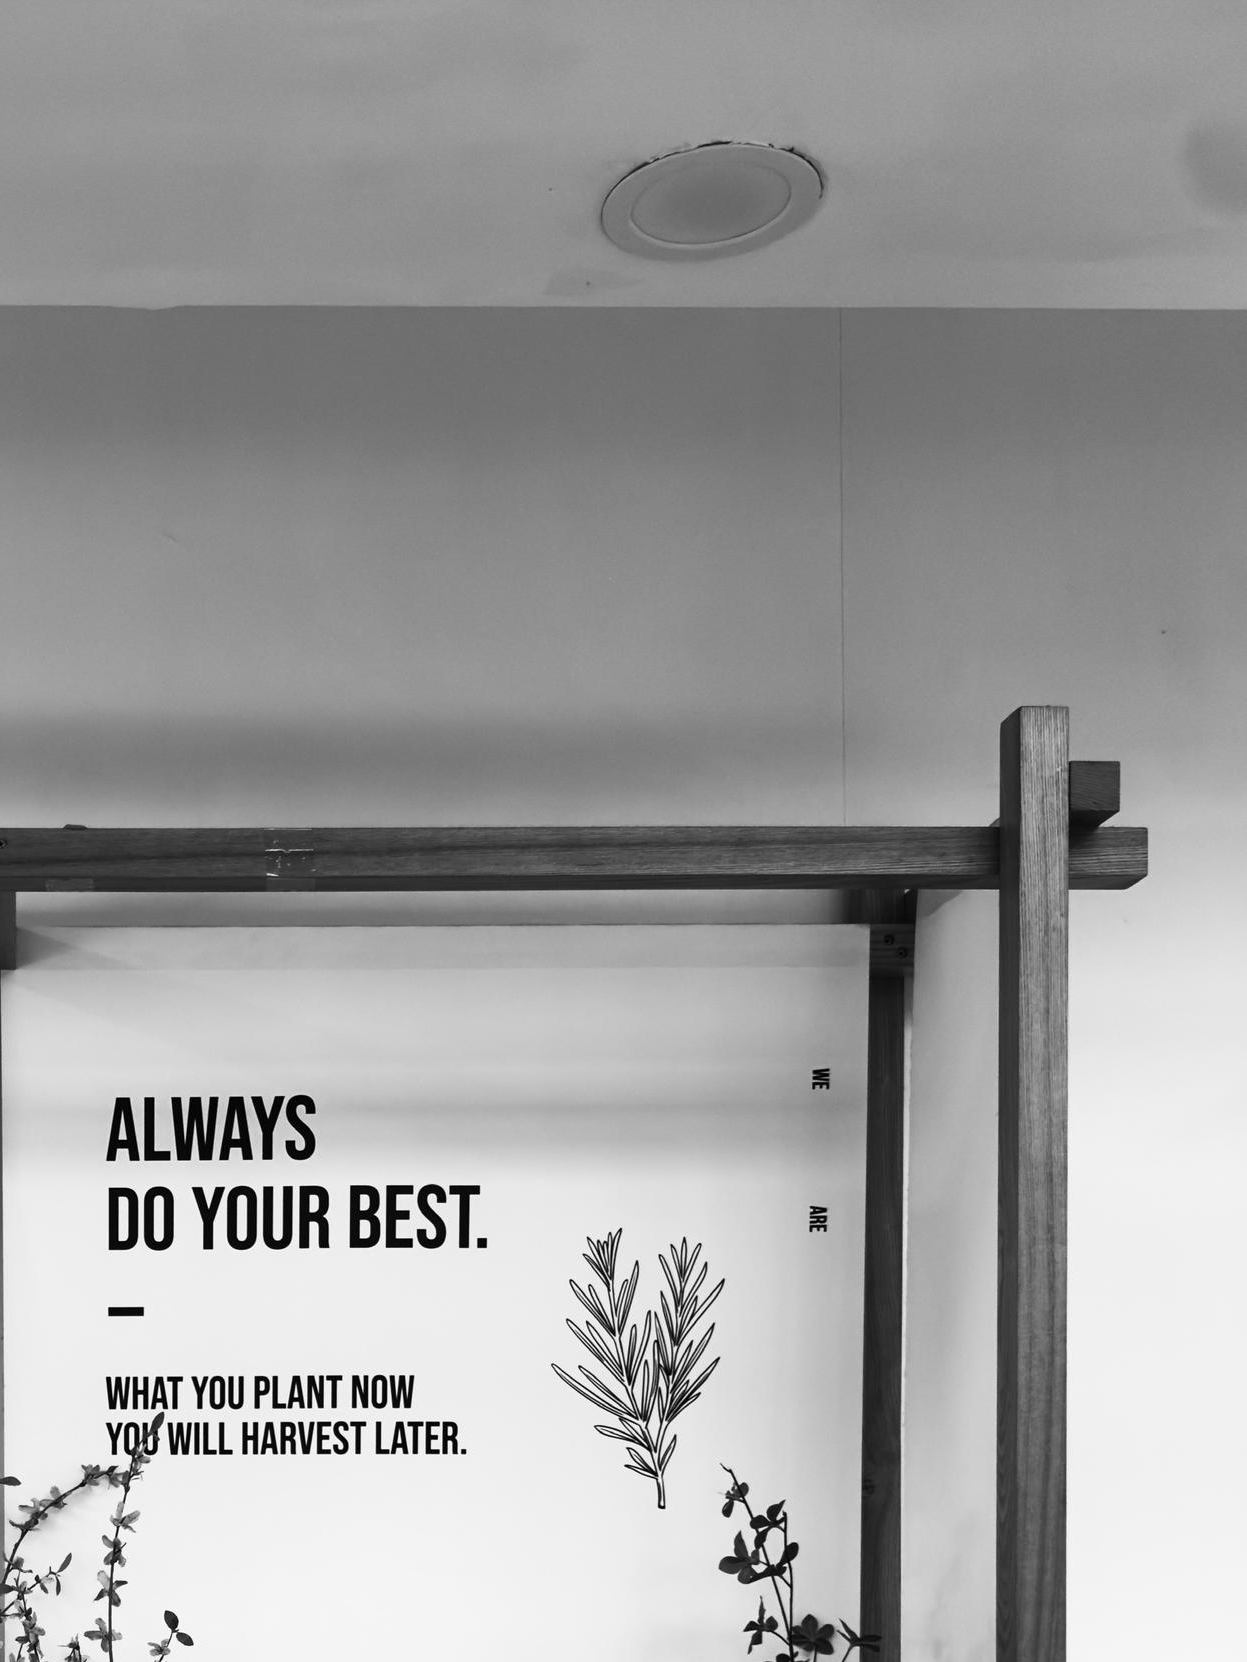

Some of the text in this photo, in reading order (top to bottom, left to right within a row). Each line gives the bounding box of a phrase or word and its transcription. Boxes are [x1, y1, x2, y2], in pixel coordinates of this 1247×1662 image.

[106, 1094, 317, 1162] ALWAYS
[809, 1068, 831, 1233] WE ARE
[107, 1183, 489, 1251] DO YOUR BEST.
[105, 1374, 415, 1411] WHAT YOU PLANT NOW
[105, 1420, 468, 1456] YOU WILL HARVEST LATER.
